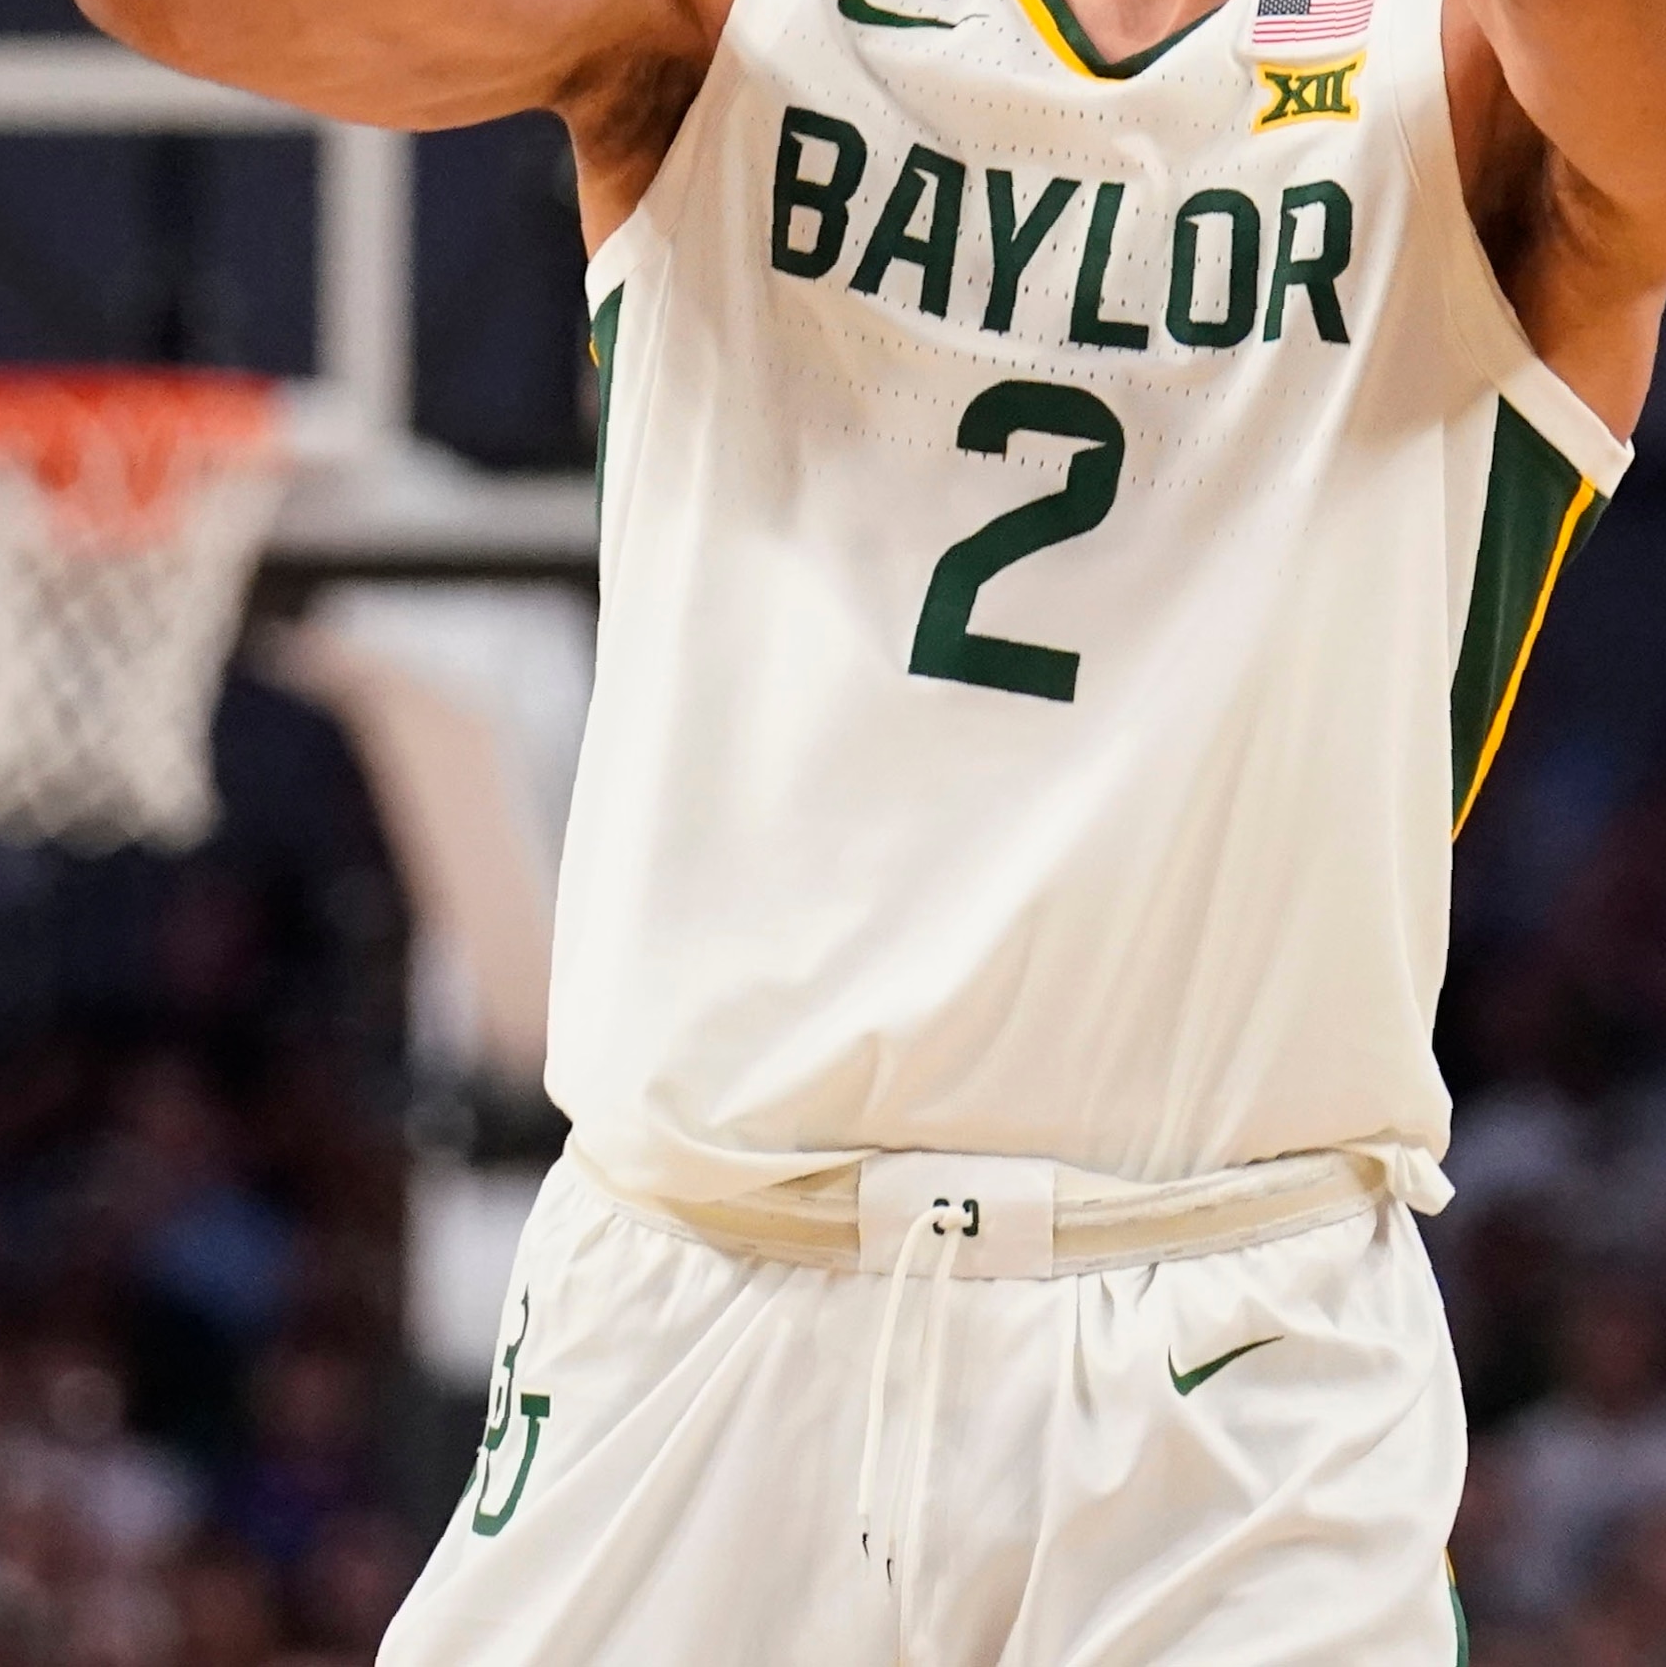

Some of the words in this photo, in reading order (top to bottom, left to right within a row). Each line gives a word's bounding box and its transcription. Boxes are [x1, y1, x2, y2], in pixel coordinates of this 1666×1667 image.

[1260, 61, 1358, 126] XII
[771, 105, 1353, 351] BAYLOR
[907, 379, 1126, 704] 2
